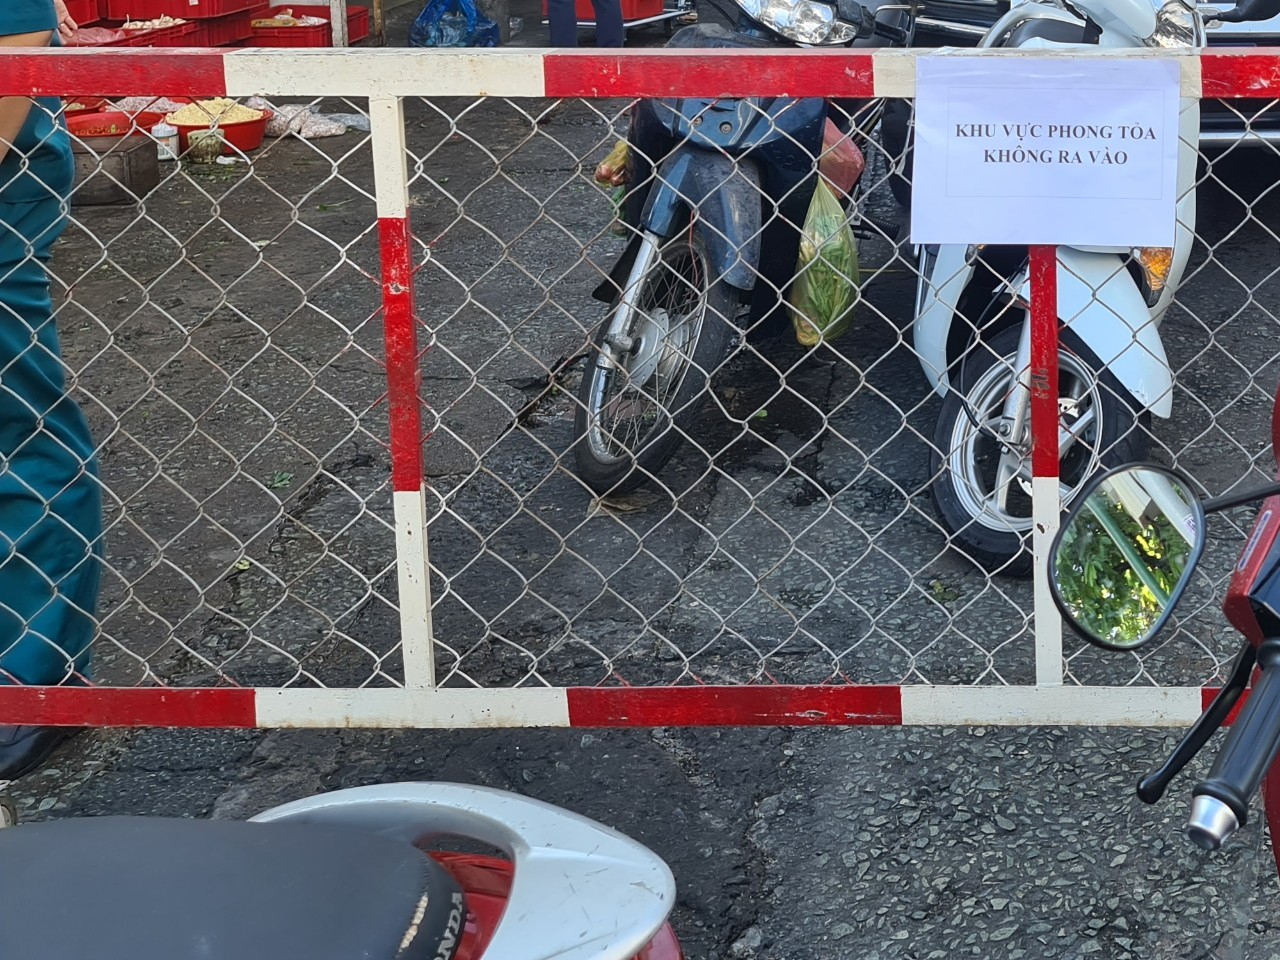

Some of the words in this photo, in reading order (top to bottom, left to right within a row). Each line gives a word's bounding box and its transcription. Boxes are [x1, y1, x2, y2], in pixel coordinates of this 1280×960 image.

[955, 124, 997, 138] KHU
[1003, 121, 1043, 141] VỰC
[1049, 124, 1112, 139] PHONG
[984, 145, 1052, 164] KHÔNG
[1058, 149, 1082, 164] RA
[1088, 146, 1128, 165] VÀO
[433, 893, 463, 960] NDA
